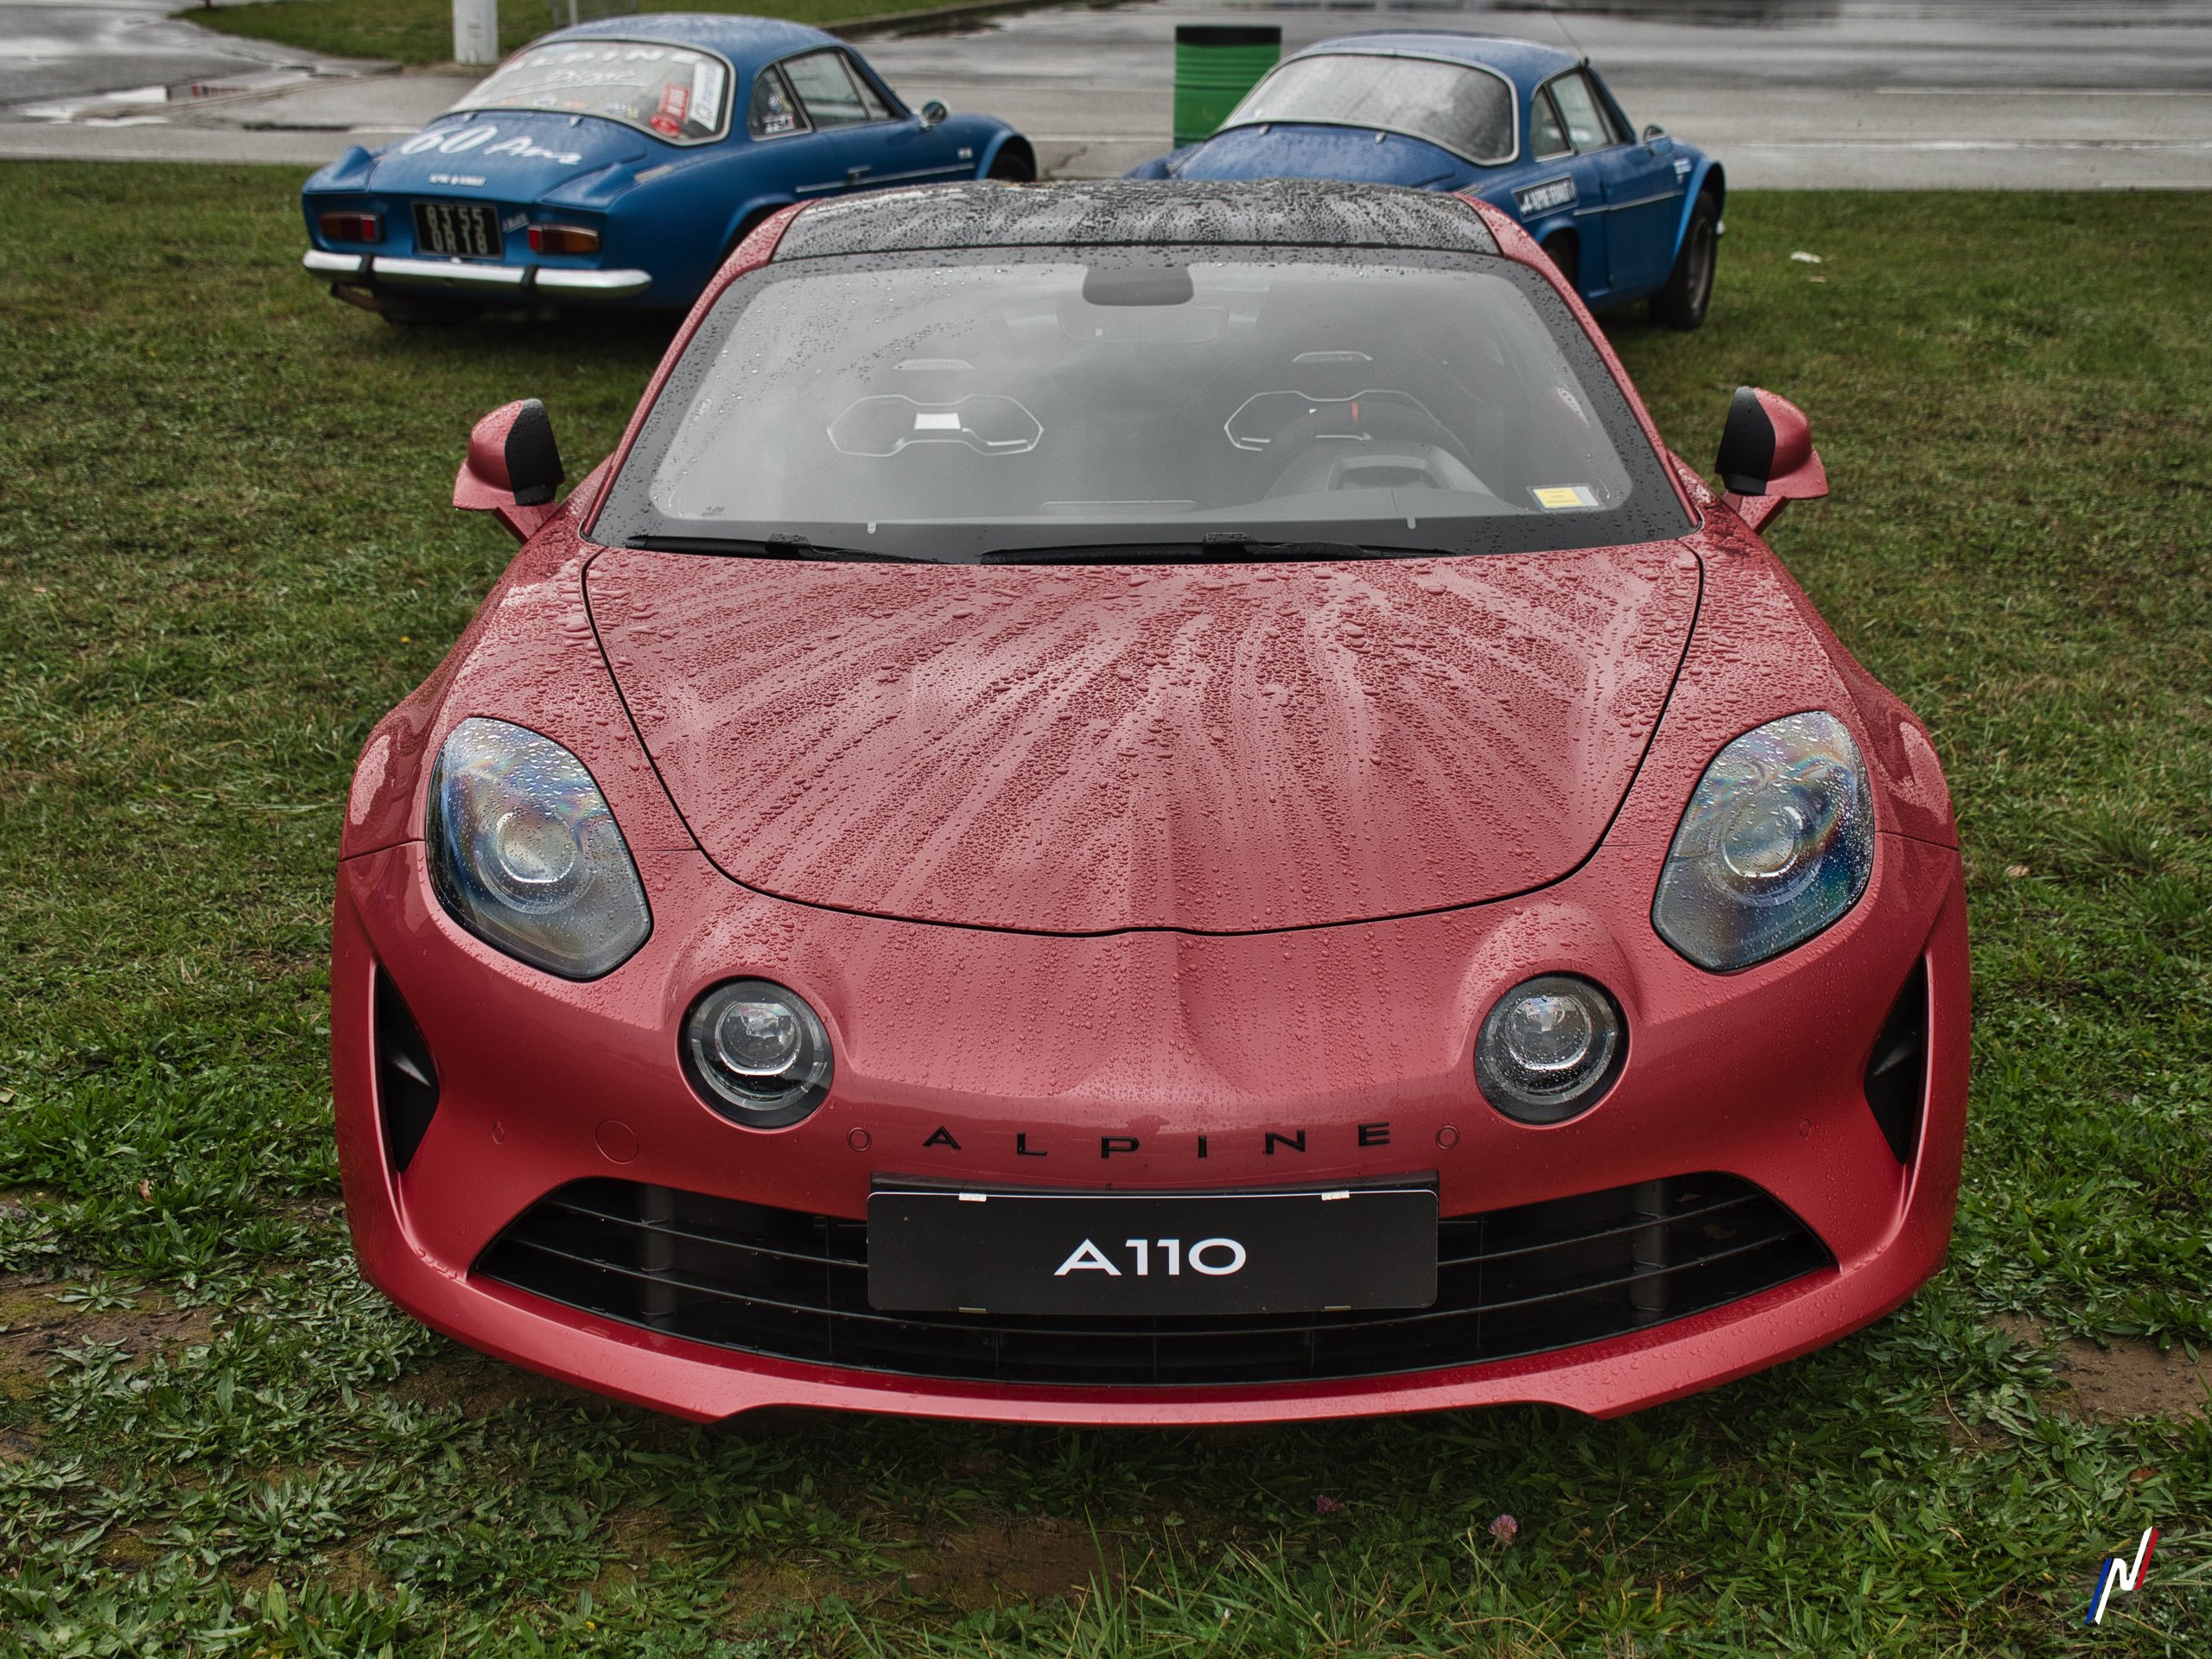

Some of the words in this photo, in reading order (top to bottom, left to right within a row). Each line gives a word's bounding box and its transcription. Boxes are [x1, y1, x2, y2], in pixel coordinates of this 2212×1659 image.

[400, 124, 499, 155] 60
[922, 1122, 1390, 1160] ALPINE
[1053, 1237, 1247, 1276] A110
